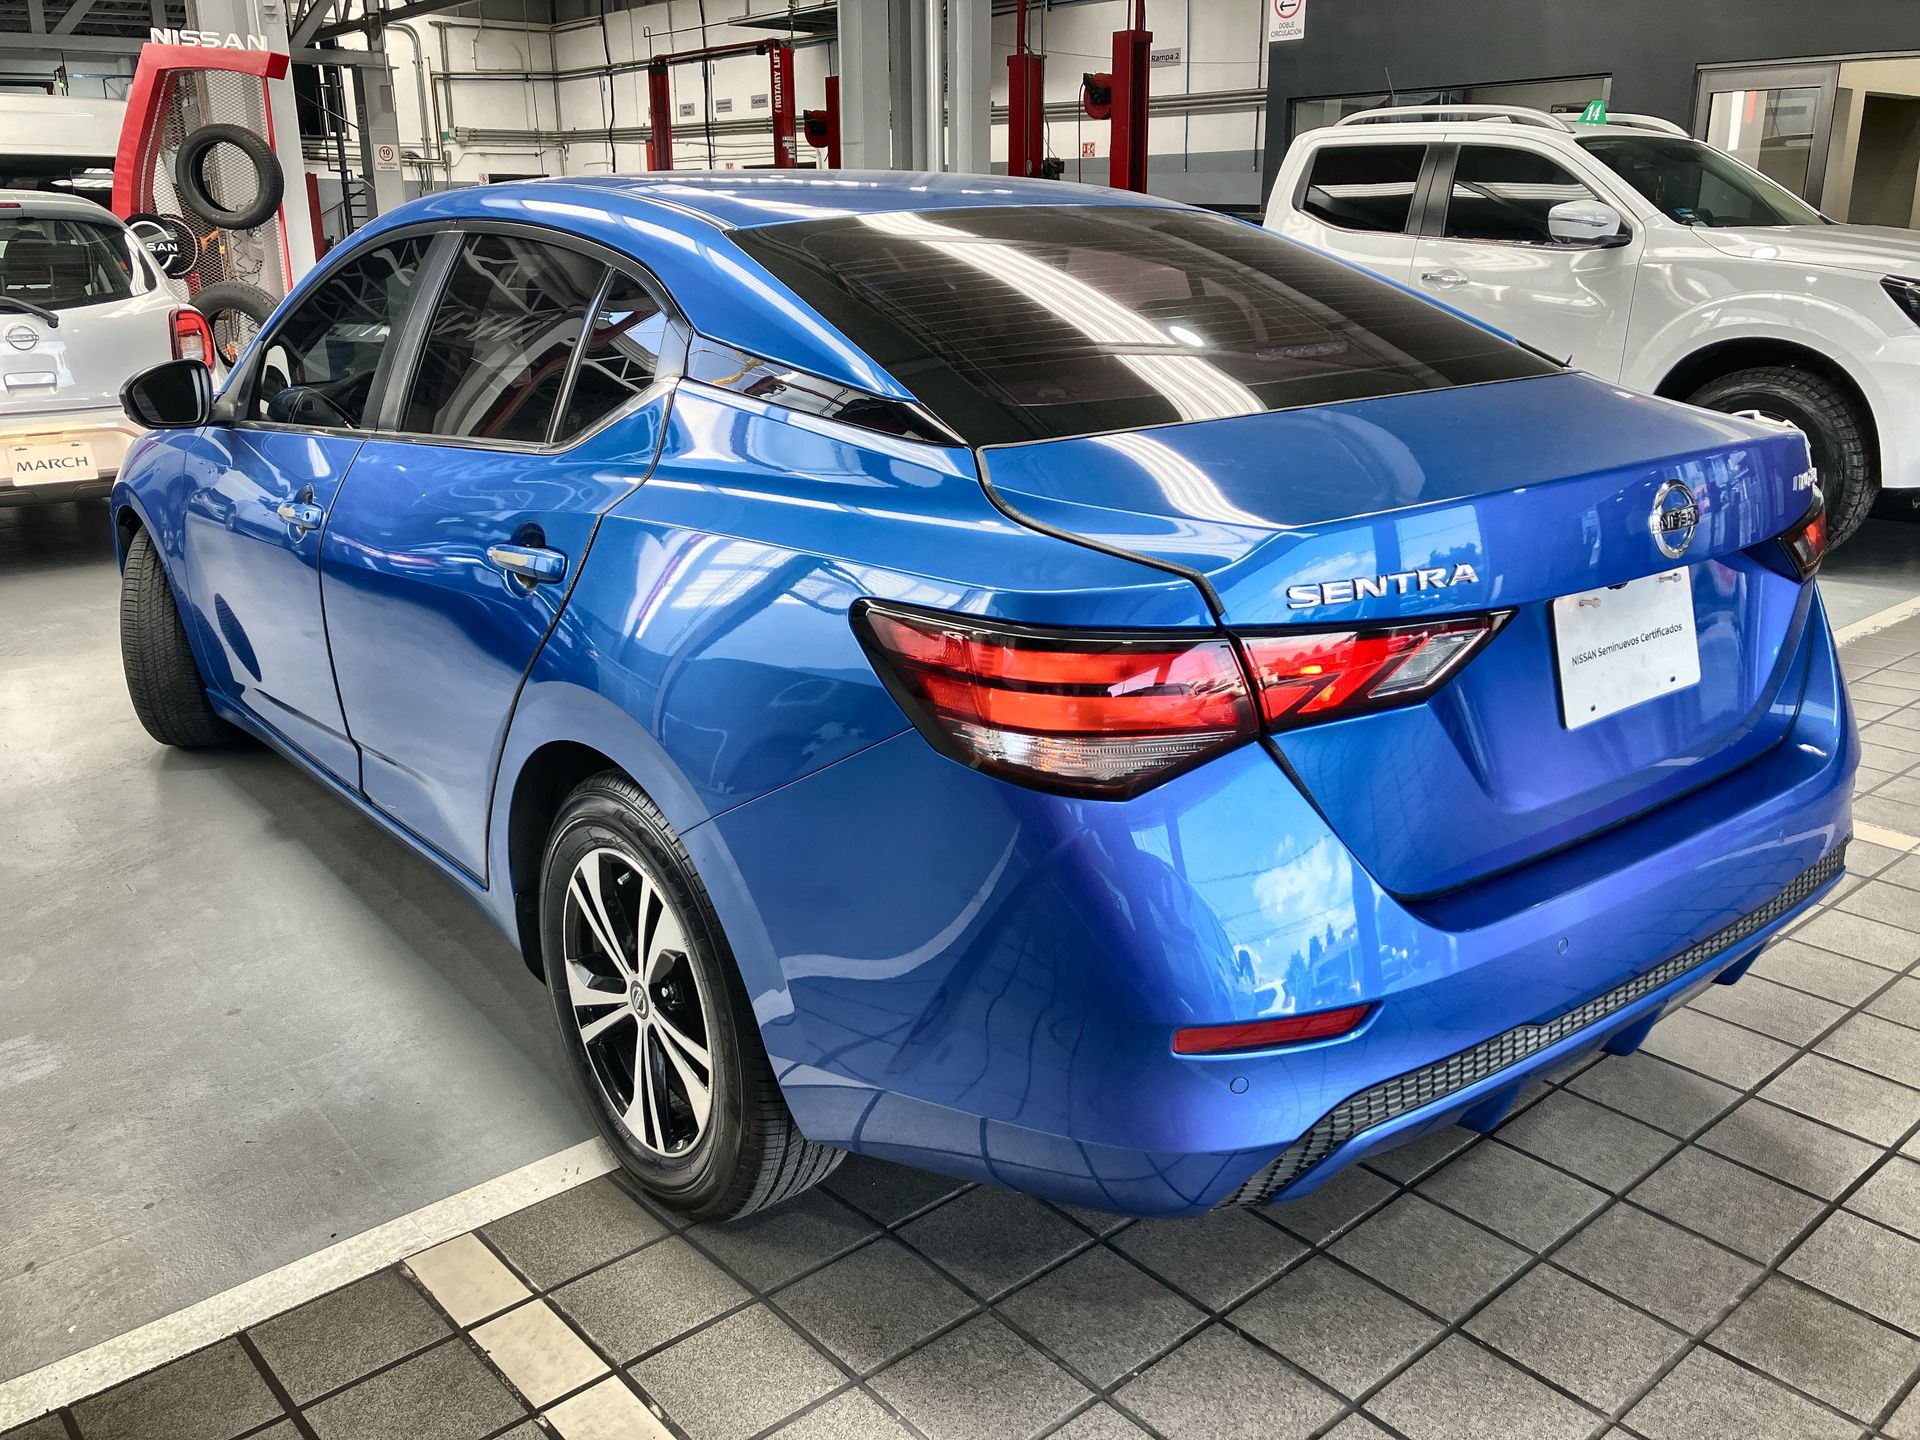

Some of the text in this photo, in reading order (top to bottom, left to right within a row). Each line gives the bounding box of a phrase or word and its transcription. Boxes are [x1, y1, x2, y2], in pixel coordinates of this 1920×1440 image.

[1278, 21, 1295, 29] DOBLE
[150, 27, 268, 51] NISSAN
[1151, 52, 1180, 63] Rampa 2
[773, 48, 782, 108] ROTARY LIFT
[1585, 103, 1602, 121] 14
[146, 243, 178, 252] SAN
[16, 456, 89, 473] MARCH
[1286, 563, 1480, 610] SENTRA
[1571, 623, 1683, 667] NISSAN Seminuevos Certificados
